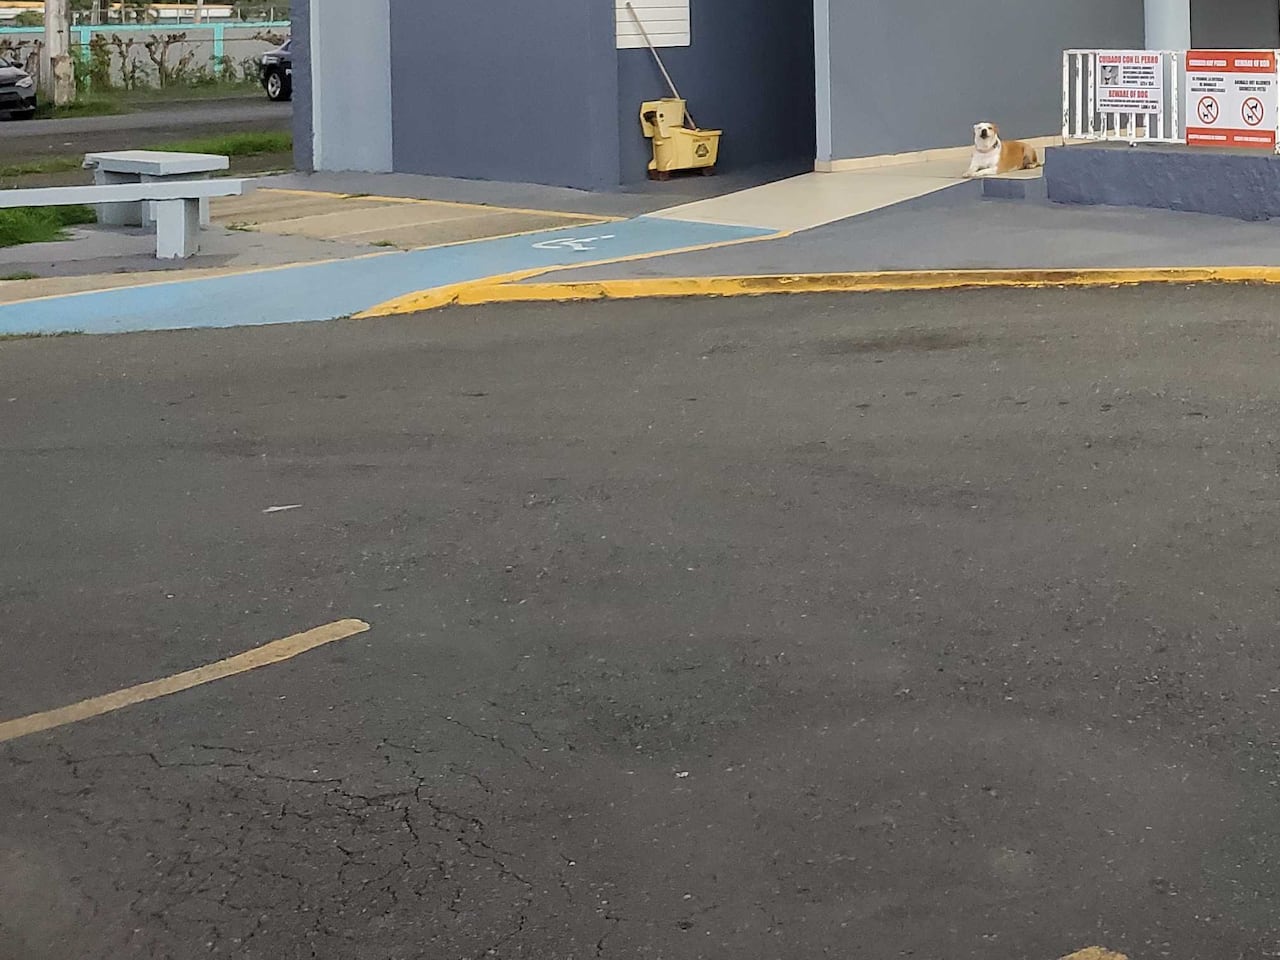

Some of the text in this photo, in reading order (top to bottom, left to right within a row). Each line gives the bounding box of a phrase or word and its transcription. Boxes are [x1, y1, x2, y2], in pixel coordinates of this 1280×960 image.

[1098, 55, 1121, 64] CUIDADO
[1122, 55, 1134, 64] CON
[1141, 55, 1159, 64] PERRO
[1108, 89, 1149, 99] BEWARE OF DOG
